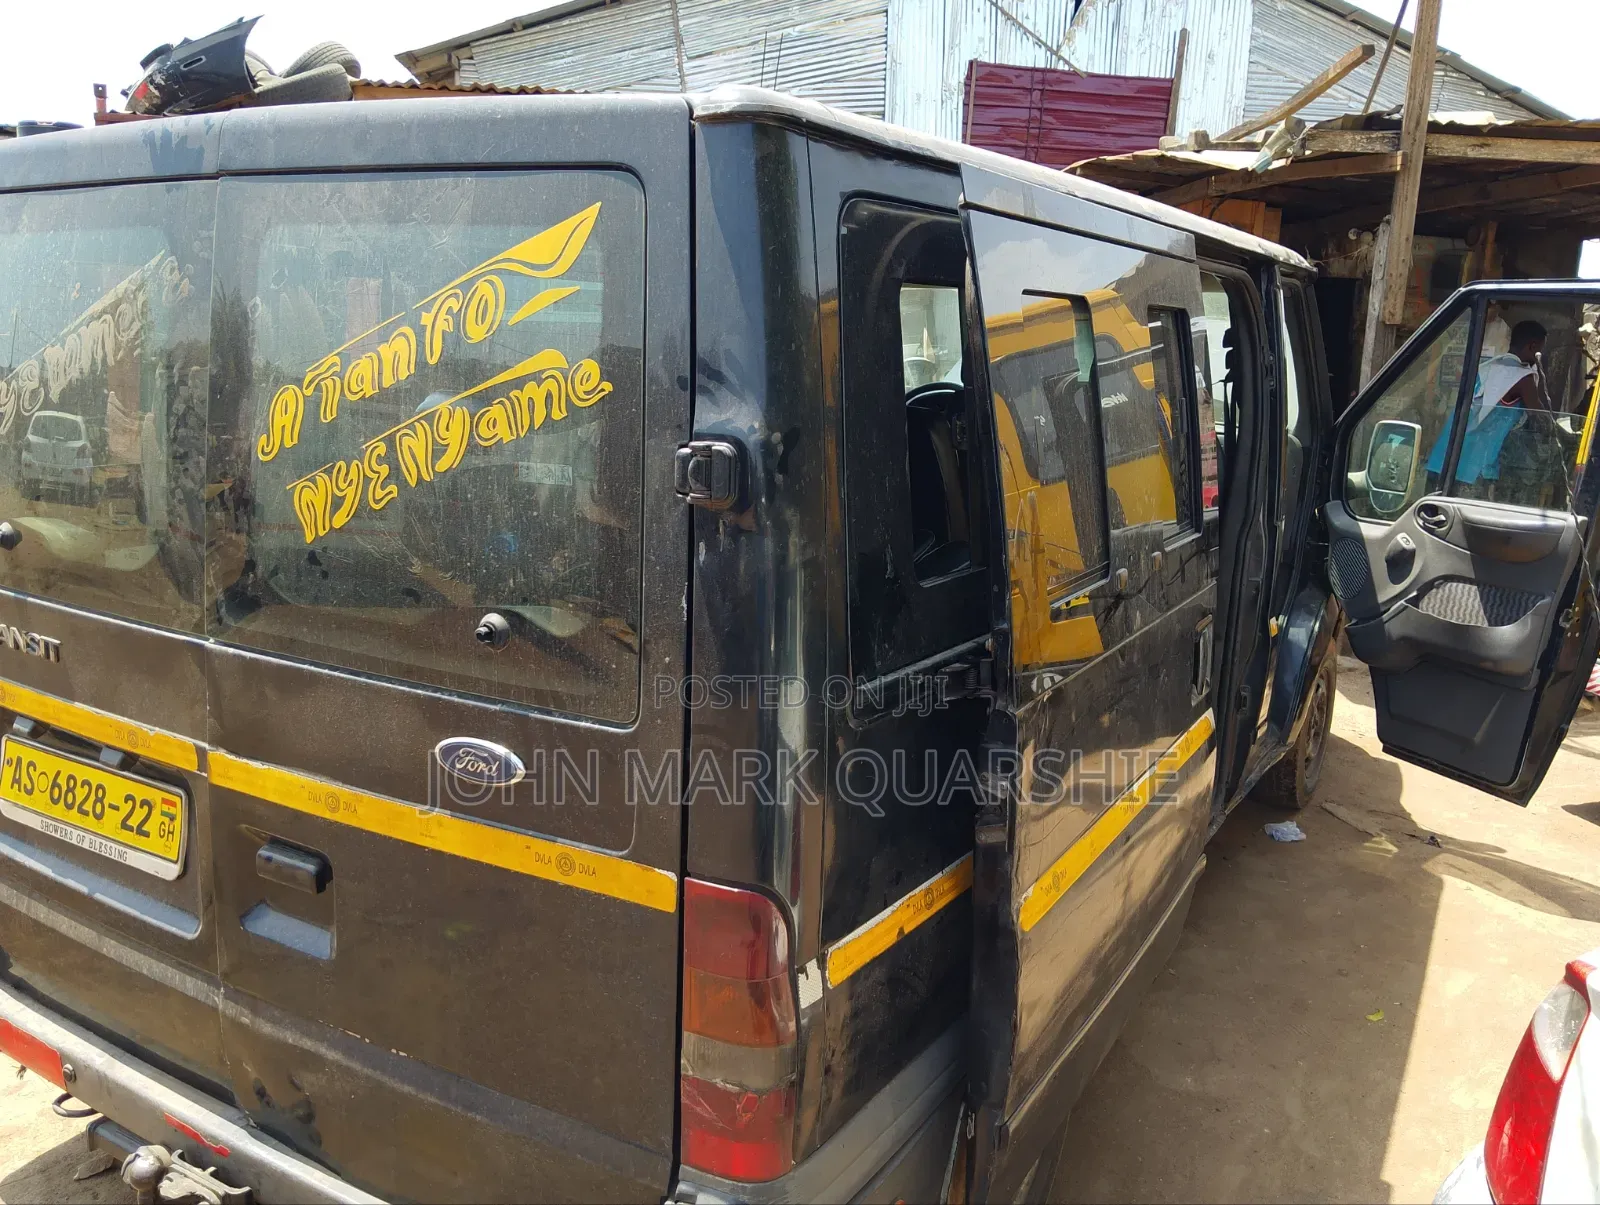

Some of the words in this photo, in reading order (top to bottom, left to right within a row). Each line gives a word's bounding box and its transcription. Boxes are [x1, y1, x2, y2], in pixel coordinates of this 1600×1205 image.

[455, 747, 500, 777] Ford
[10, 755, 37, 796] AS
[50, 769, 151, 839] 6828-22
[40, 819, 74, 841] SHOWERS
[76, 834, 86, 846] OF
[88, 840, 128, 862] BLESSING
[158, 820, 176, 842] GH
[534, 851, 553, 866] DVLA
[578, 863, 597, 879] DVLA
